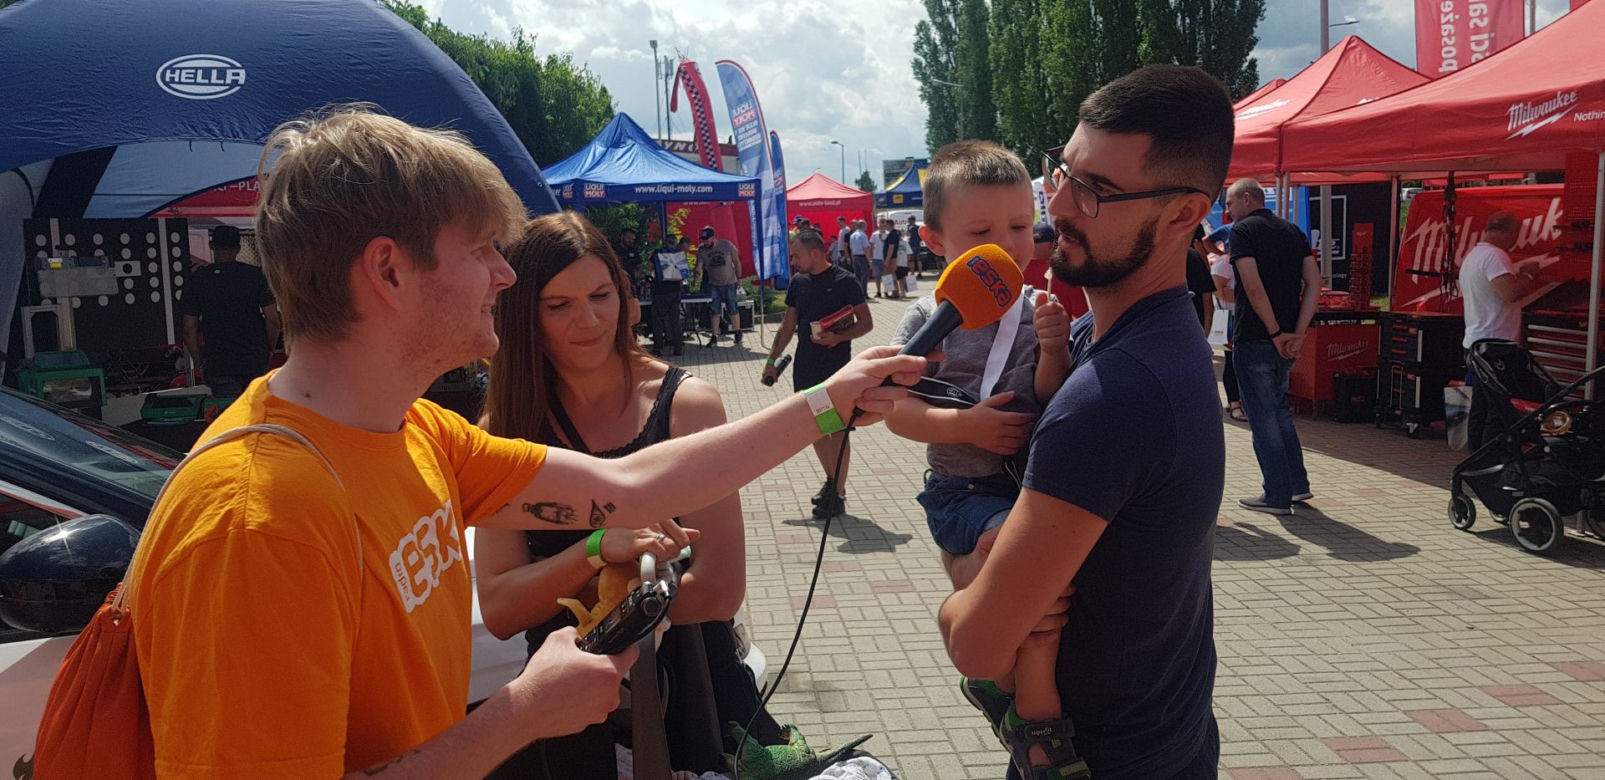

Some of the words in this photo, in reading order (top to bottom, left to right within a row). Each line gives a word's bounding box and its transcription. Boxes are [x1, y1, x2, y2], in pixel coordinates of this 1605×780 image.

[165, 68, 246, 85] HELLA
[1505, 90, 1577, 132] Milwaukee
[635, 184, 713, 194] www.liqui-moly.com
[971, 258, 1012, 308] eska
